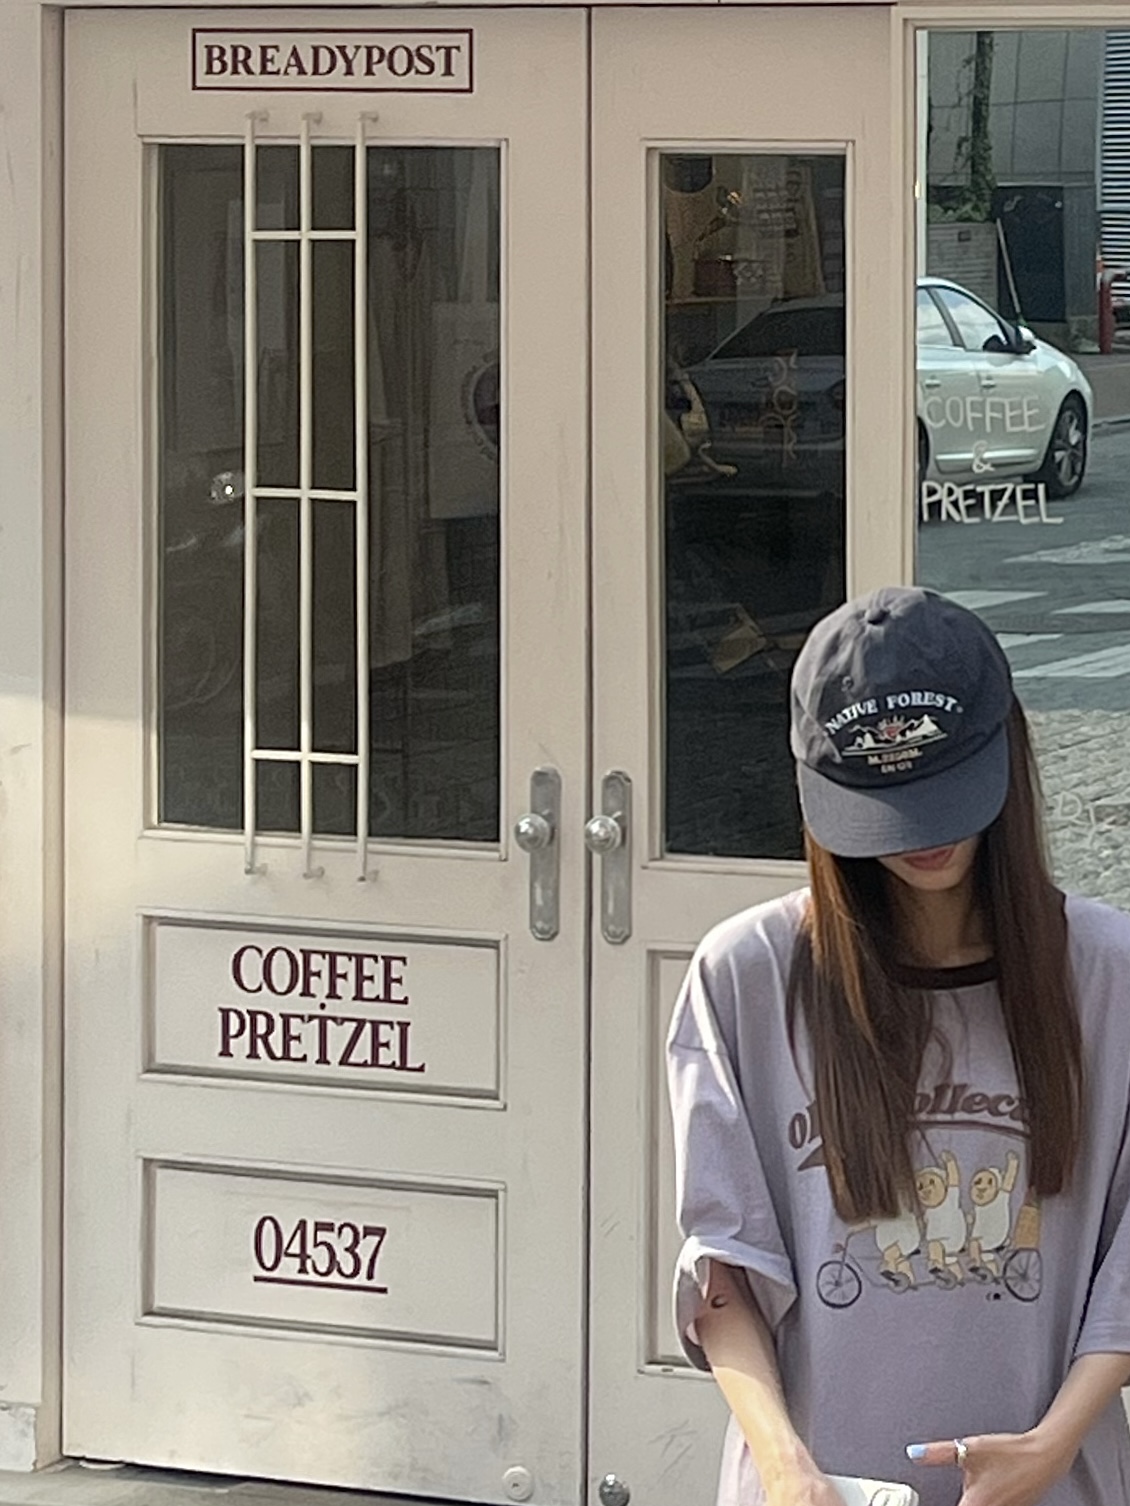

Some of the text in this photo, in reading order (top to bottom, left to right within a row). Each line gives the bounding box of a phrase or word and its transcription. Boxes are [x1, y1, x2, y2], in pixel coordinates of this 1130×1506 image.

[204, 44, 461, 77] BREADYPOST
[925, 396, 1048, 433] COFFEE
[972, 440, 996, 474] &
[921, 480, 1064, 525] PRETZEL
[824, 698, 879, 735] NATIVE
[231, 945, 410, 1006] COFFEE
[217, 1007, 426, 1073] PRETZEL
[254, 1215, 389, 1282] 04537
